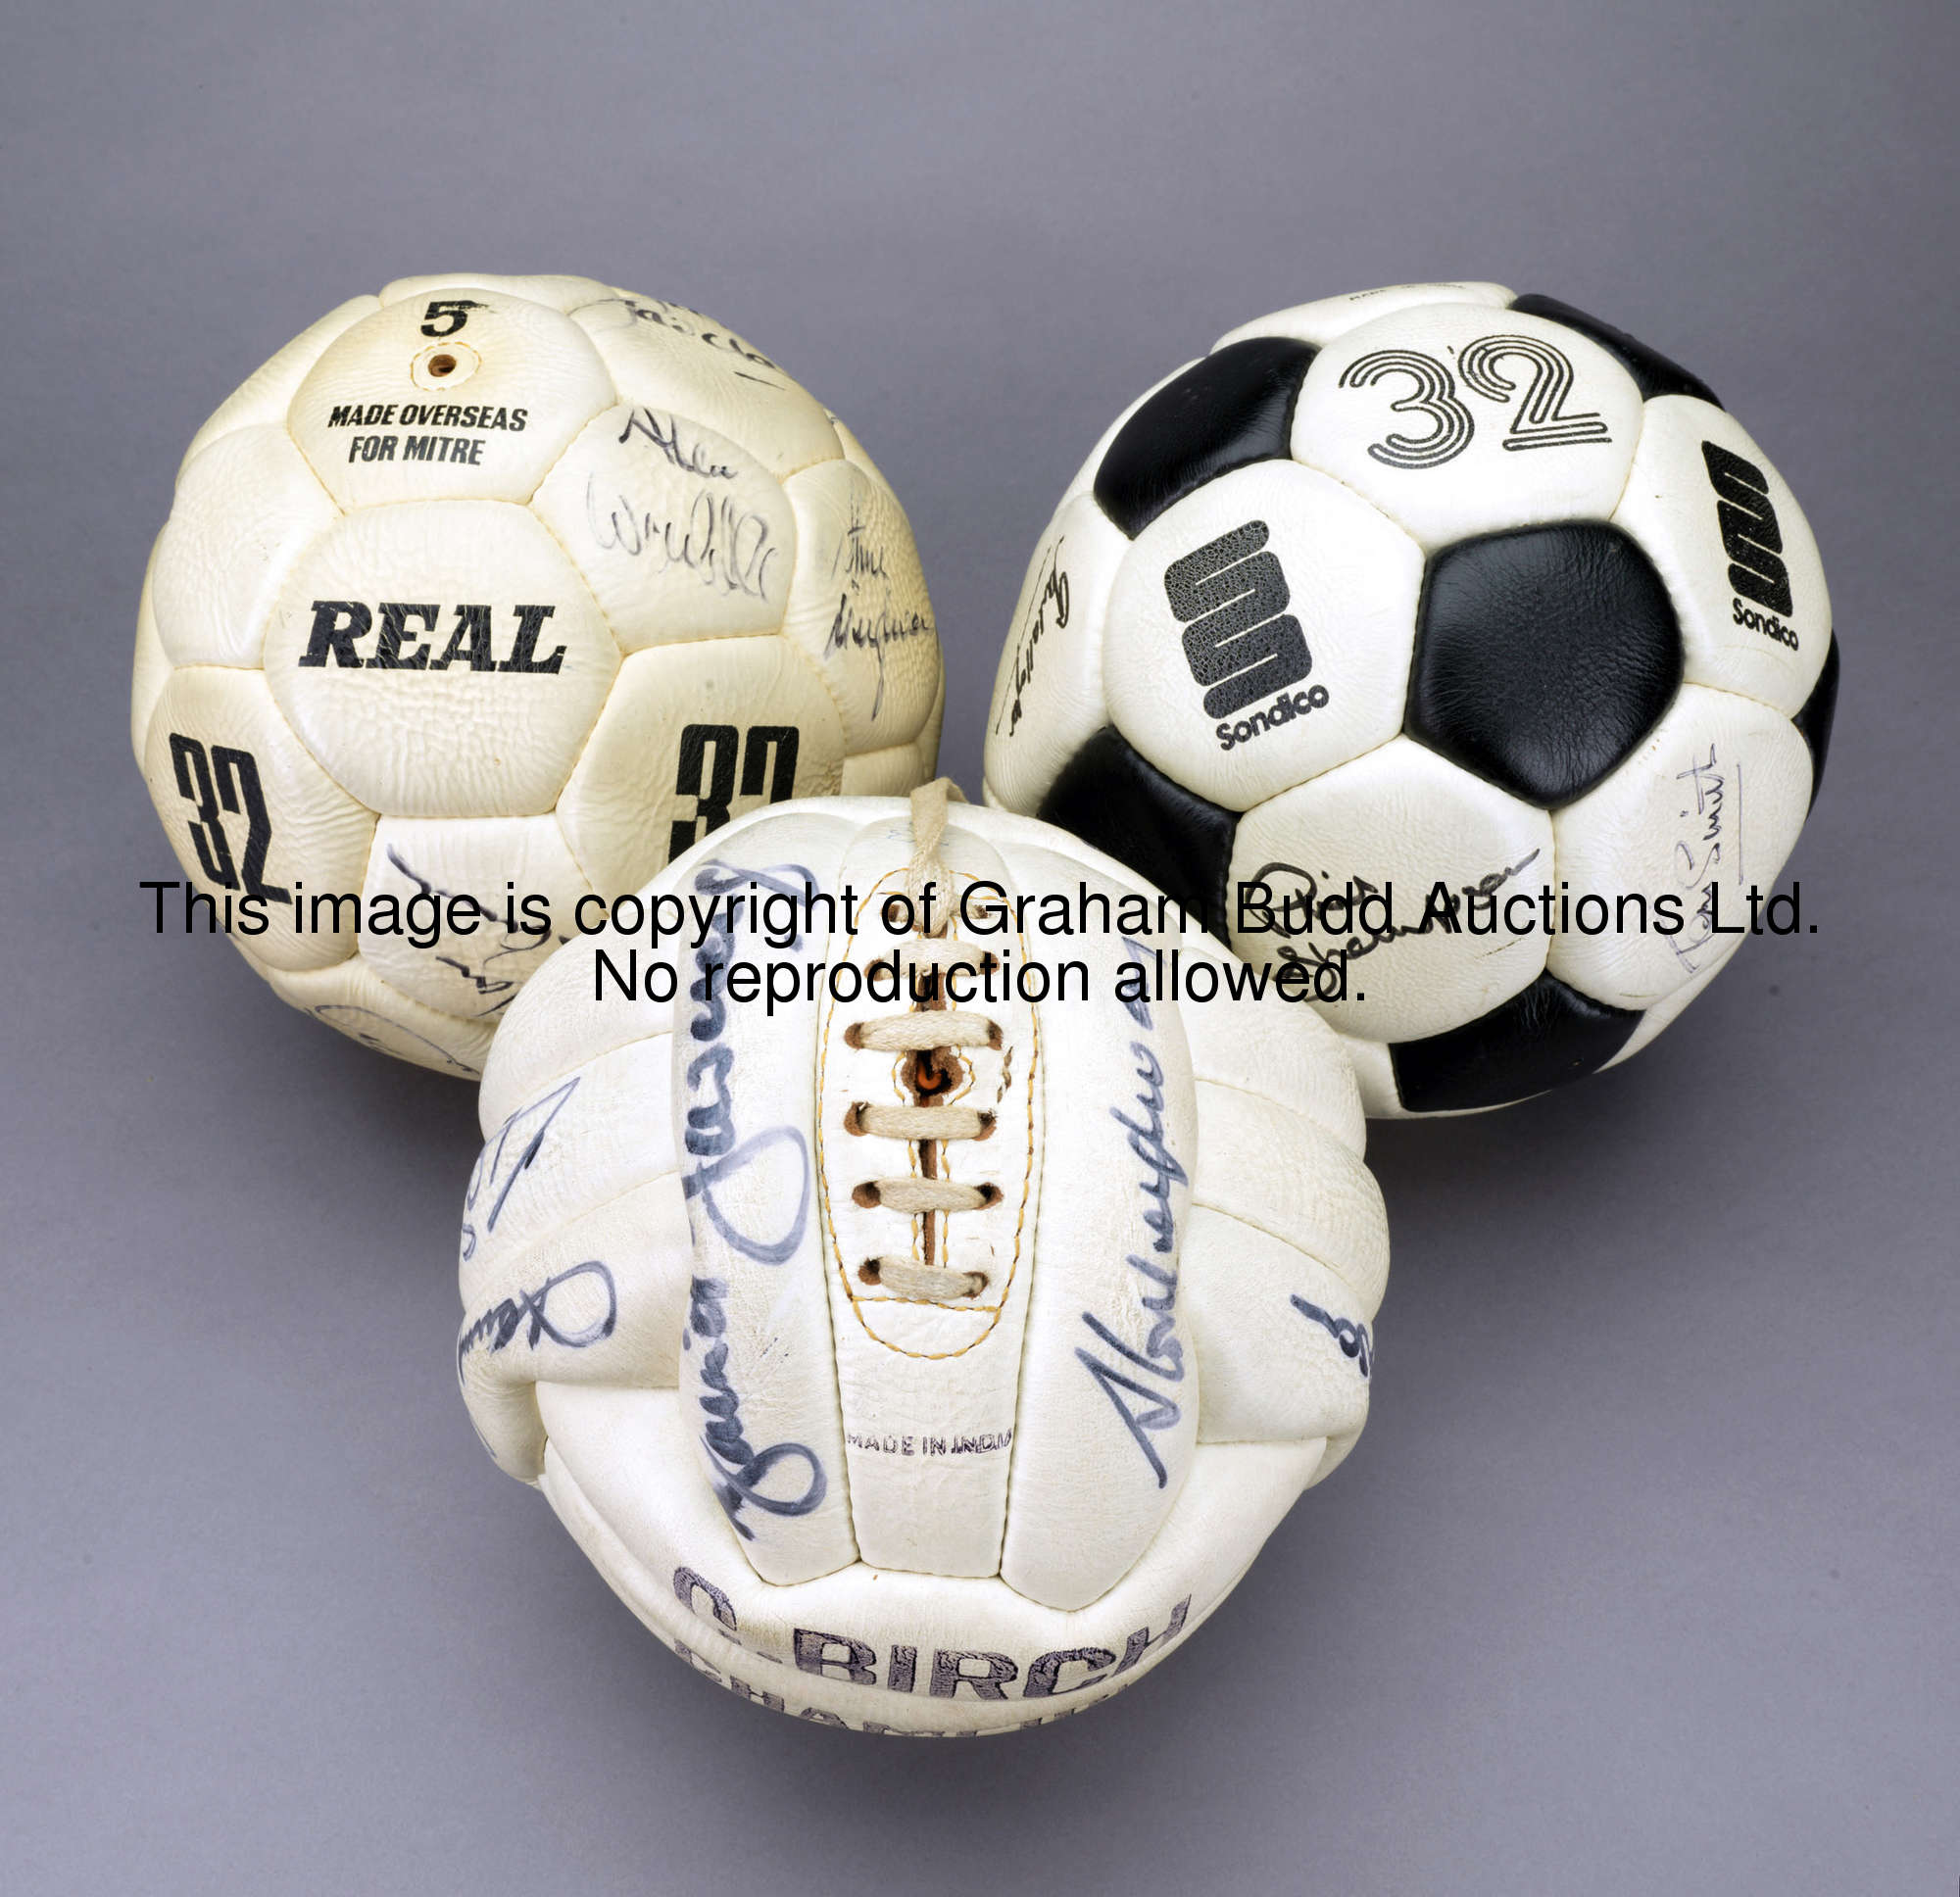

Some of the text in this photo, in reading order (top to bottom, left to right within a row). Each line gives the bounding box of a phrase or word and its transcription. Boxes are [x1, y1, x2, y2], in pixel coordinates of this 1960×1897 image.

[420, 300, 470, 338] 5
[328, 404, 528, 432] MADE OVERSEAS
[1339, 334, 1612, 469] 32
[349, 435, 486, 465] FOR MITRE
[299, 600, 567, 675] REAL
[1733, 597, 1799, 652] Sondico
[1215, 685, 1330, 751] Sondico
[170, 732, 292, 904] 32
[847, 1432, 915, 1456] MADE
[922, 1435, 947, 1456] IN
[793, 1593, 1192, 1700] BIRCH
